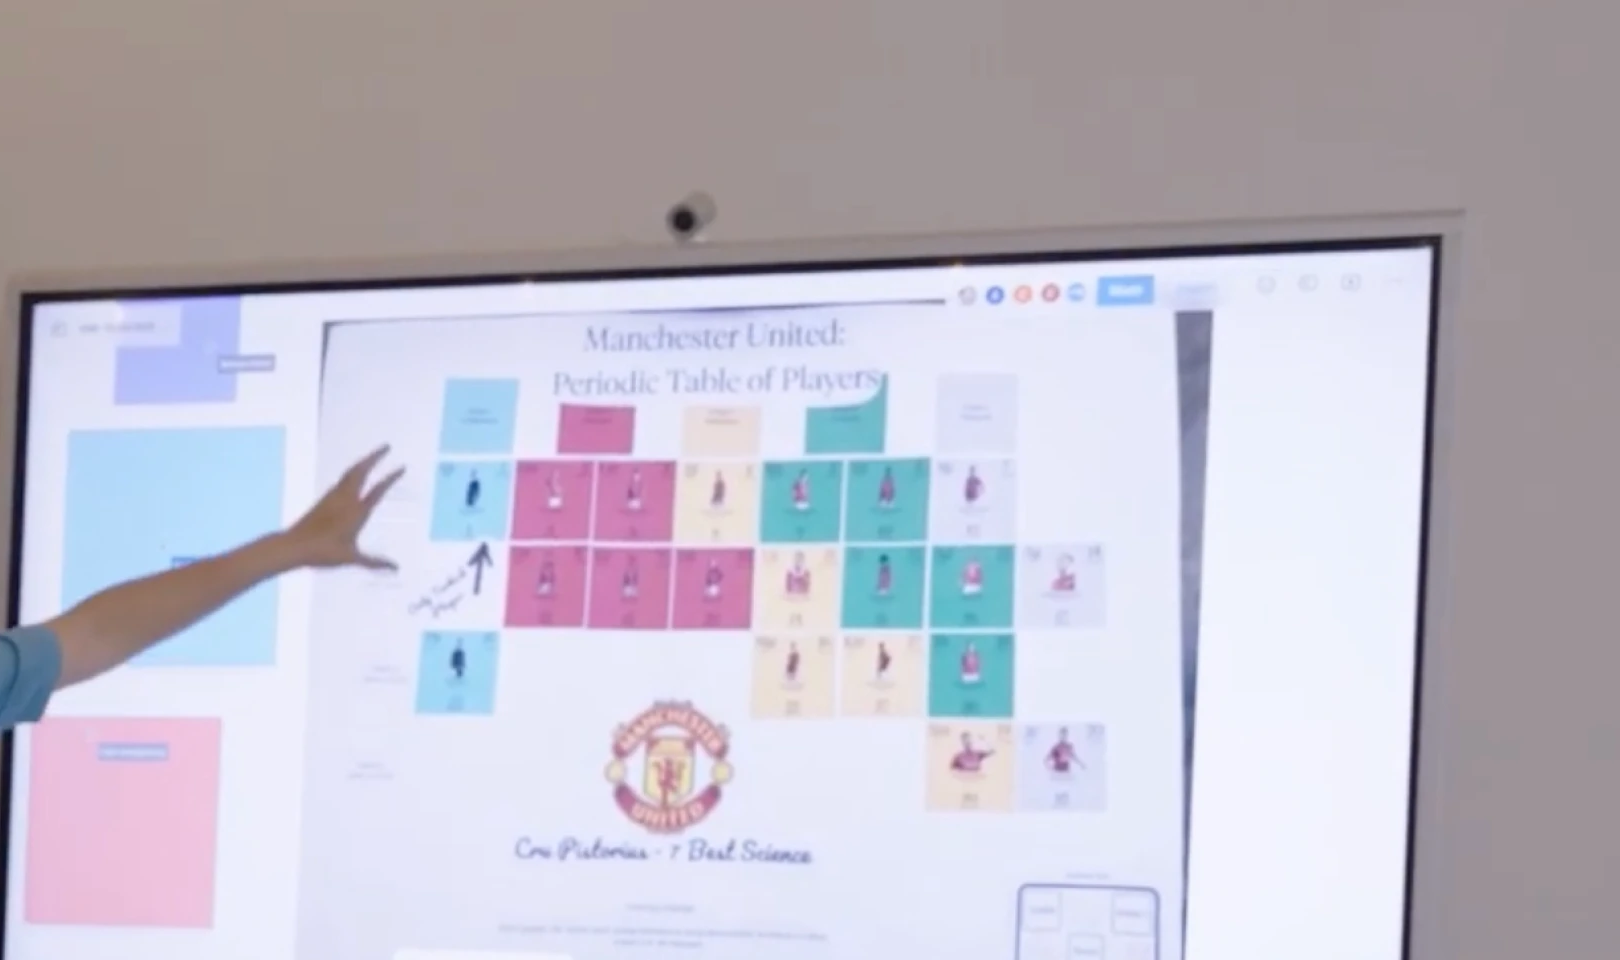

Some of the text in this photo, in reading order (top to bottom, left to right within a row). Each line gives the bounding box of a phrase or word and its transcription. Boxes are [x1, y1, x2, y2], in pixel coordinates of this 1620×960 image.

[583, 318, 846, 353] Manchester United:
[552, 364, 880, 399] Periodic Table of Players
[740, 838, 813, 866] Science
